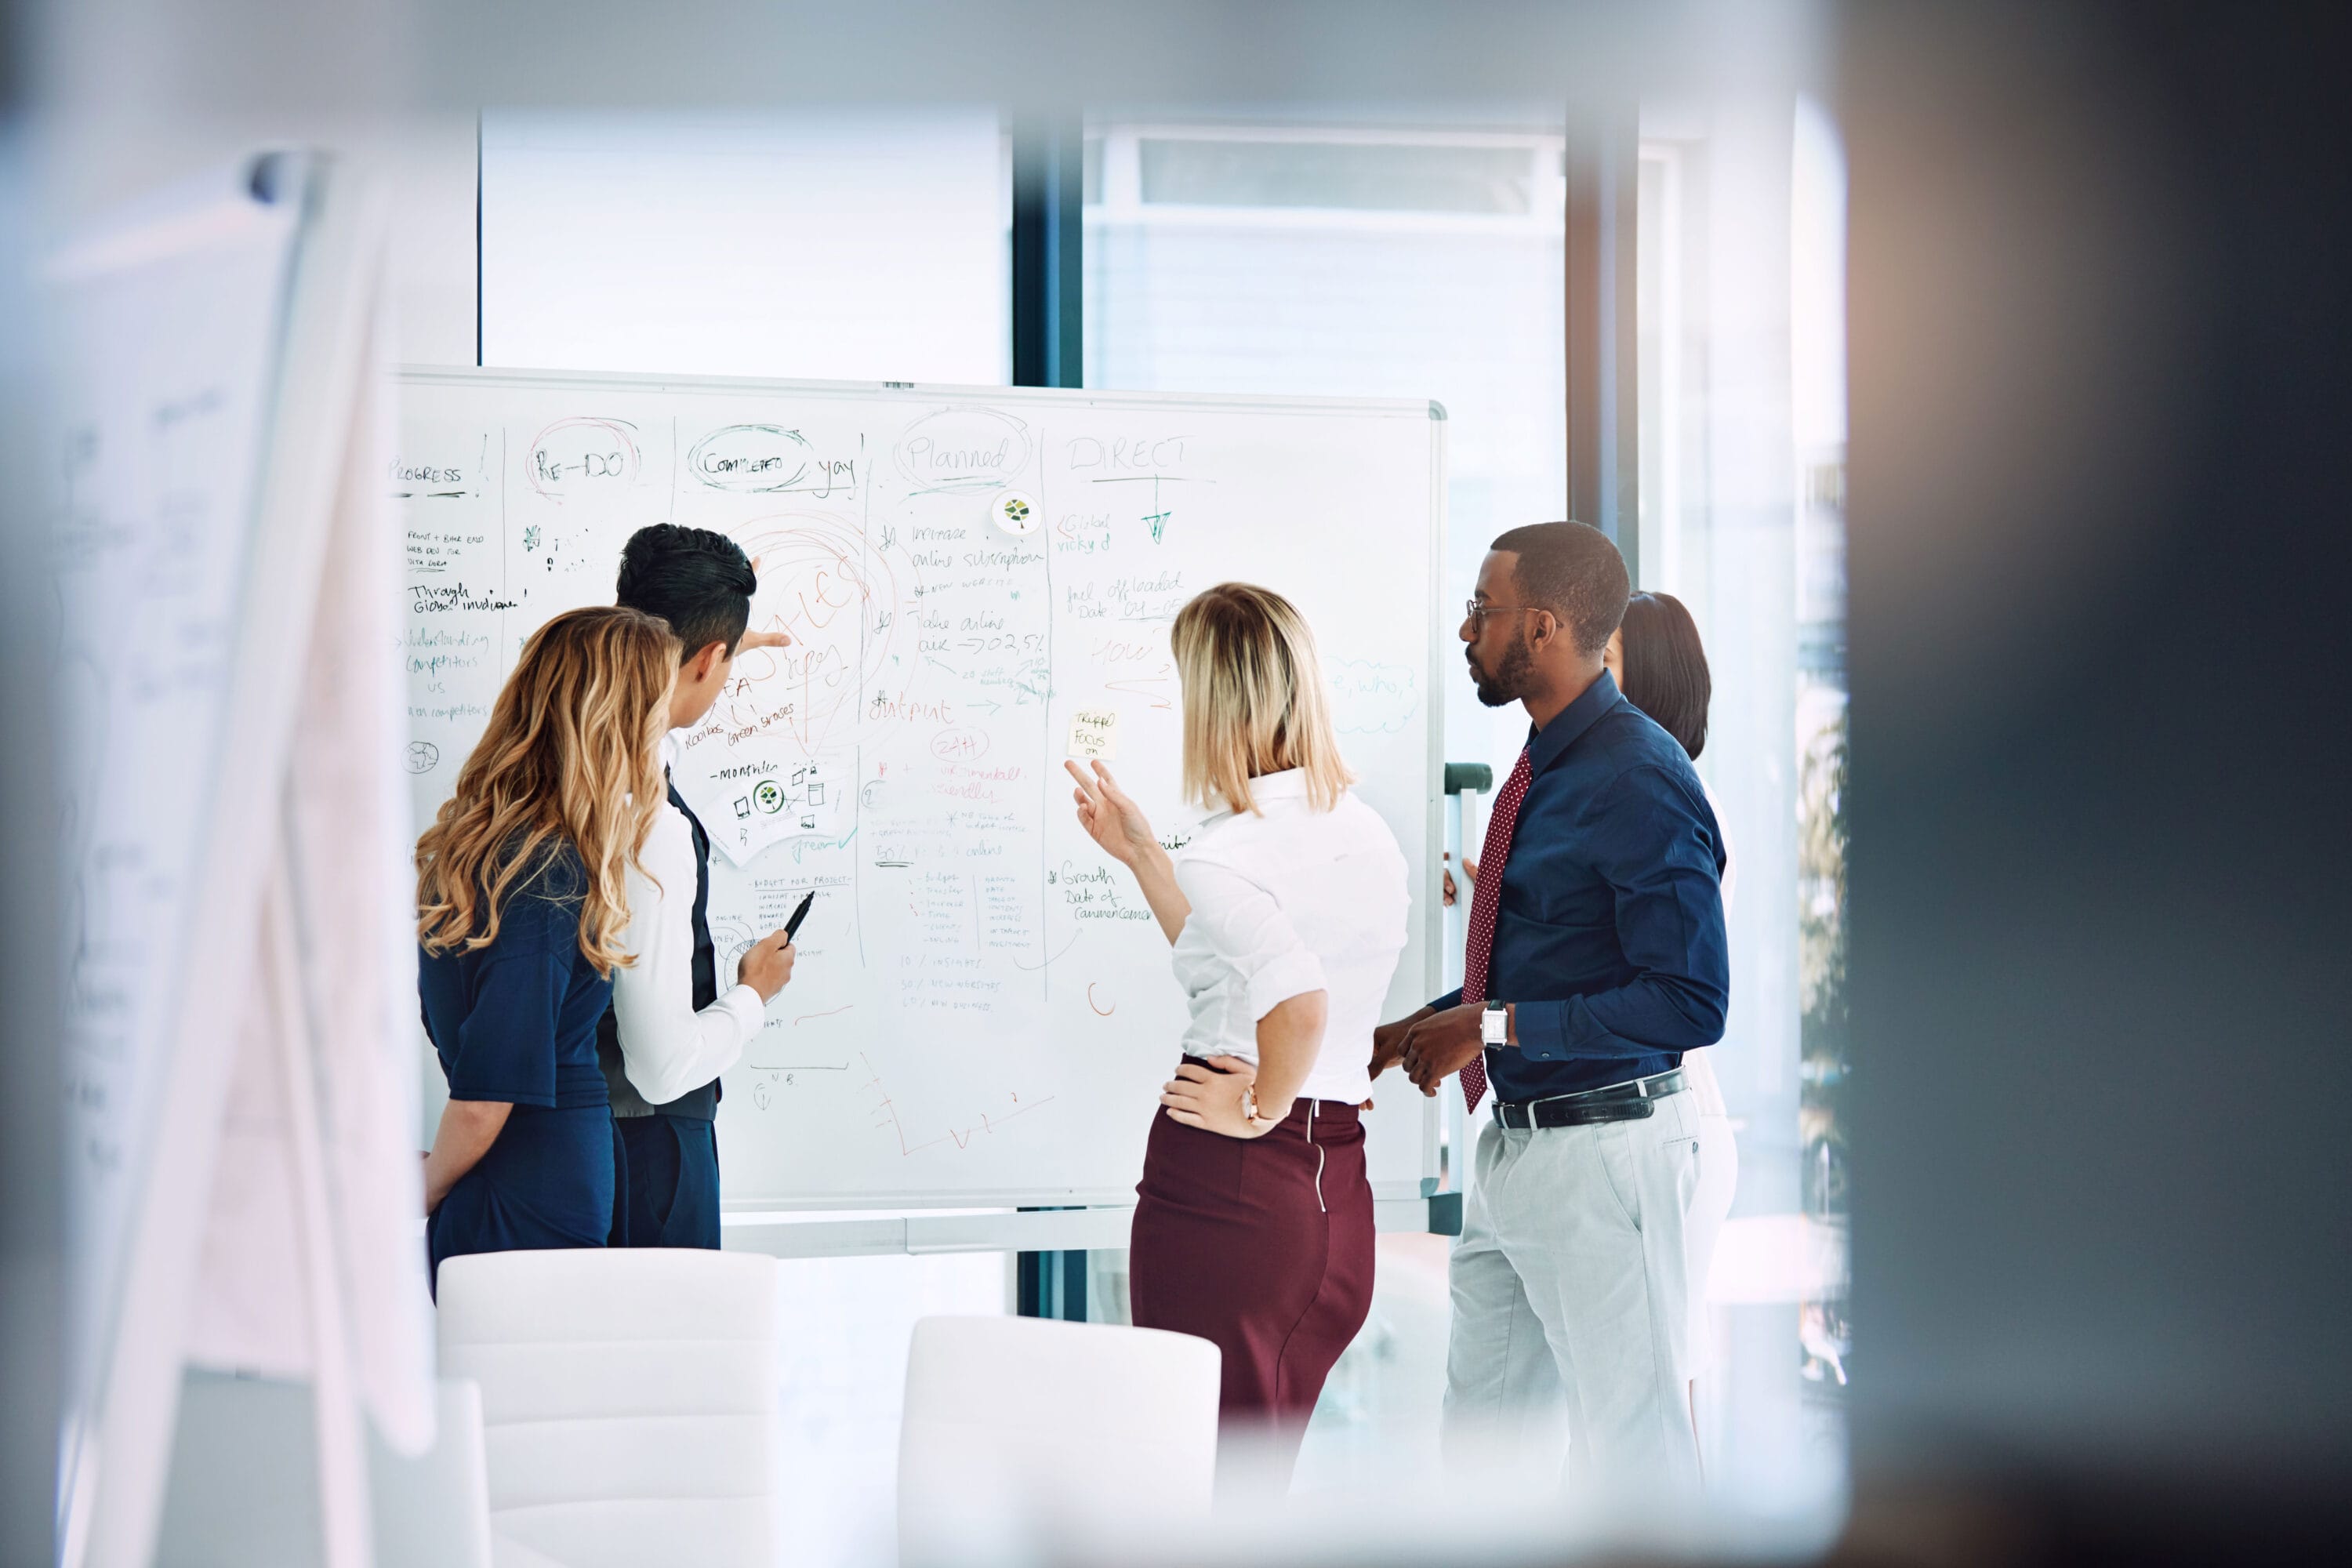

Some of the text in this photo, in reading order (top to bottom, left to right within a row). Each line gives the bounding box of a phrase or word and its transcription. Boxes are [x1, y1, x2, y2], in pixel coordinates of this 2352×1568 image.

[907, 437, 1011, 474] Planned
[1065, 435, 1197, 470] DIRECT
[407, 545, 423, 554] WEB
[1062, 859, 1116, 886] Growth
